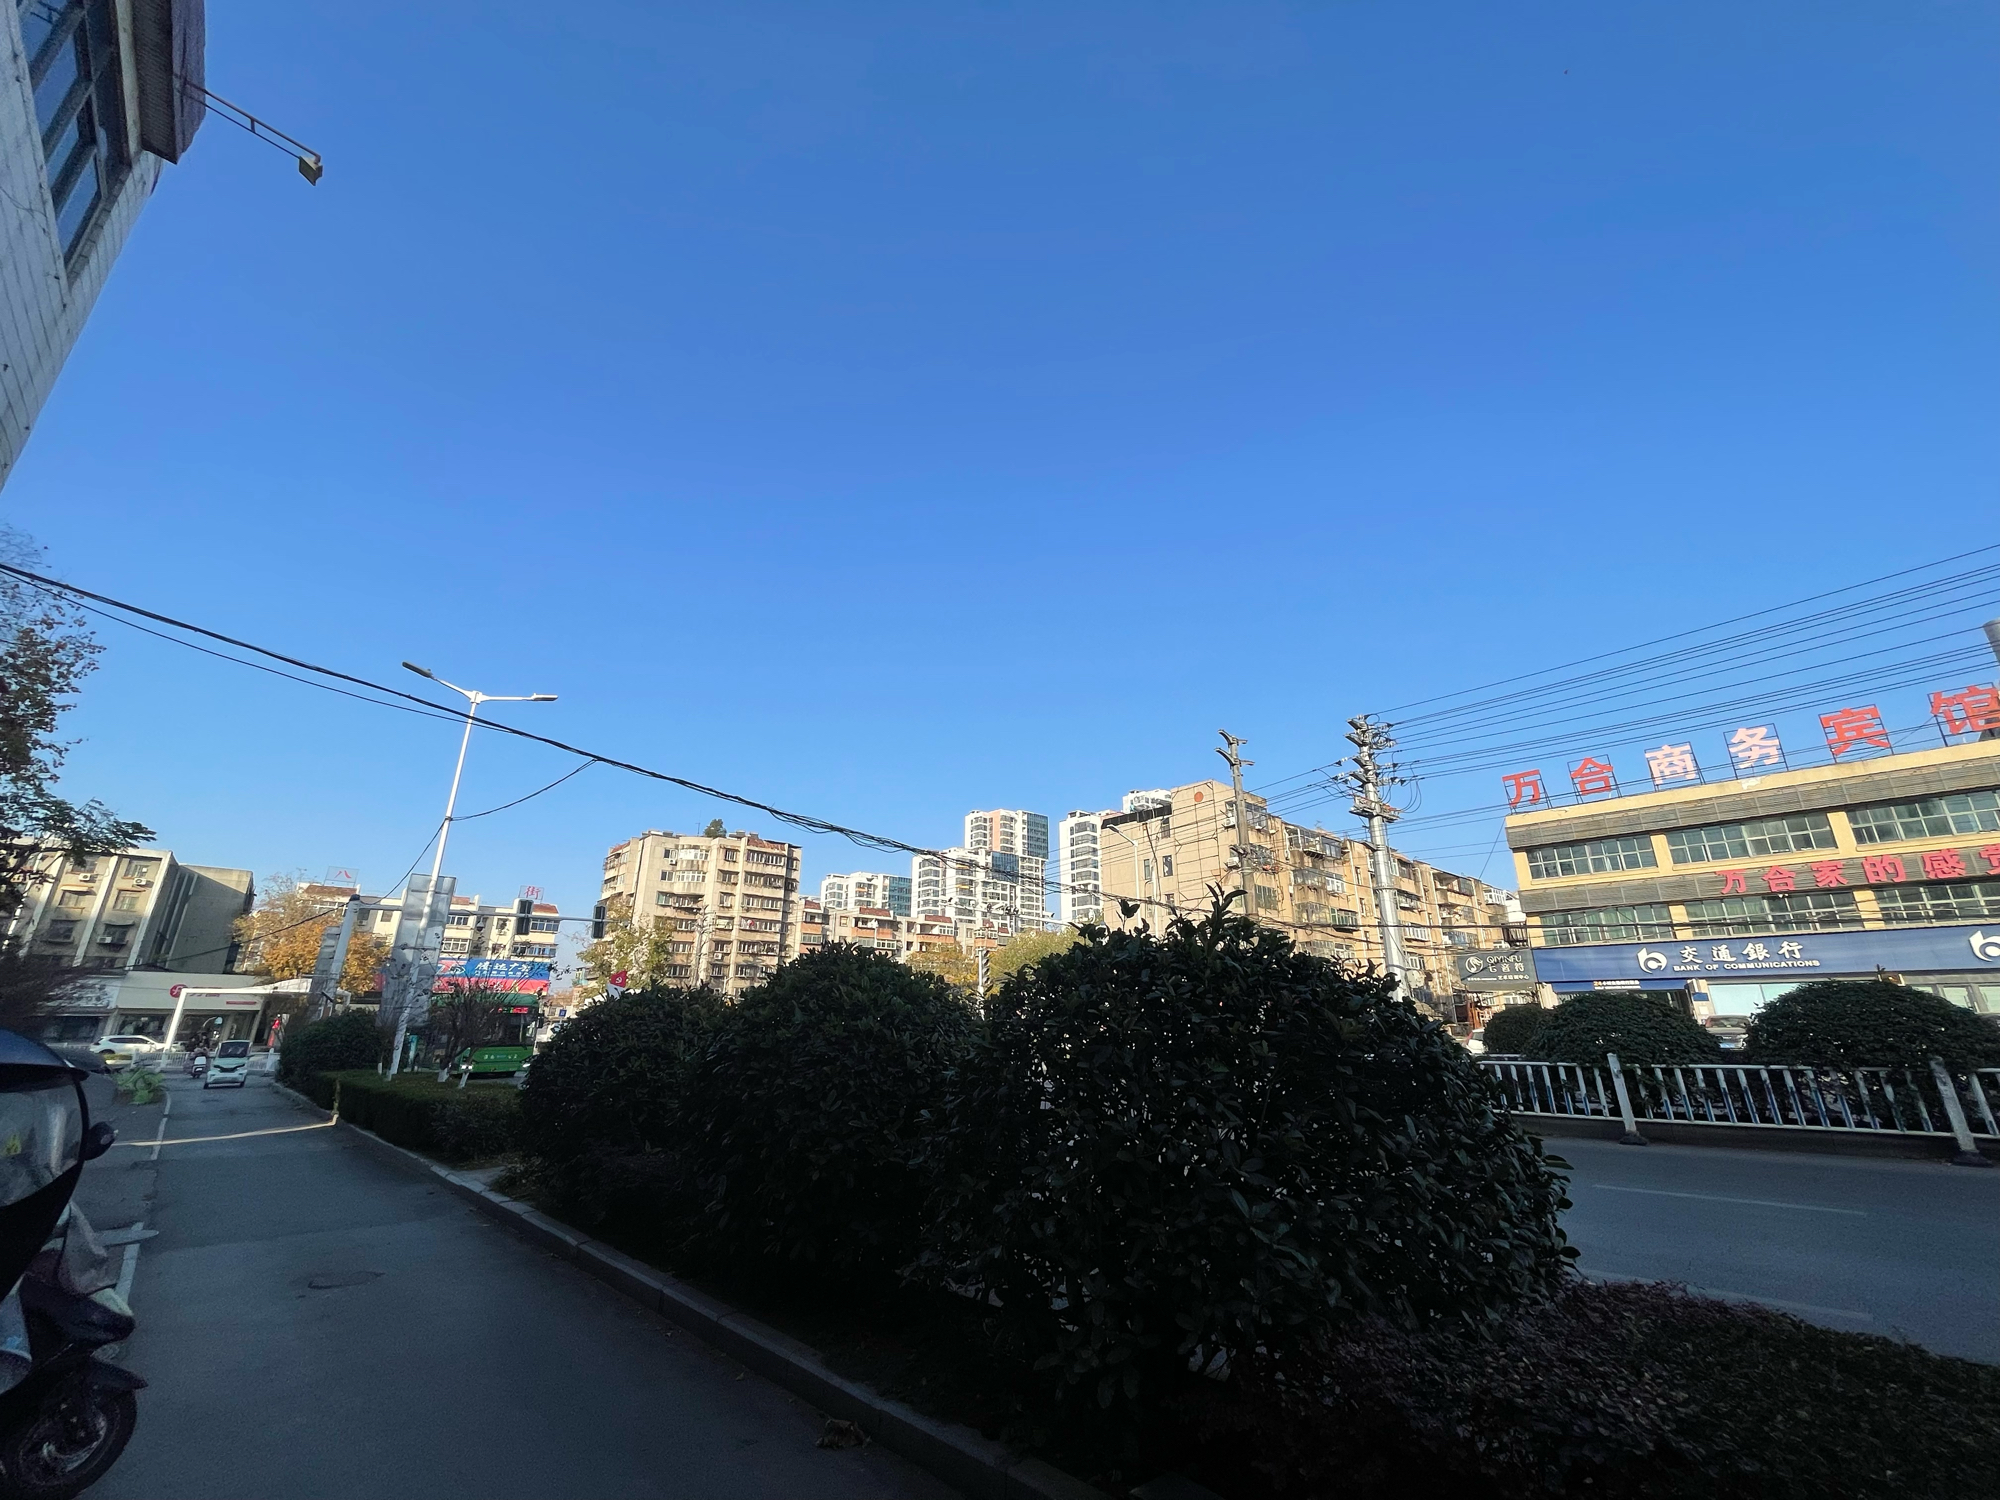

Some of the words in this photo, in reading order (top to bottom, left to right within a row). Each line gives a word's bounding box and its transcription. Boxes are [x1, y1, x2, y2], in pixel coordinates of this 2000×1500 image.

[1502, 685, 2000, 808] 万合商务宾馆
[1486, 955, 1522, 964] QIYINFU
[1680, 941, 1804, 963] 交通銀行
[1673, 964, 1702, 972] BANK
[1705, 963, 1719, 971] OF
[1723, 959, 1821, 971] COMMUNICATIONS
